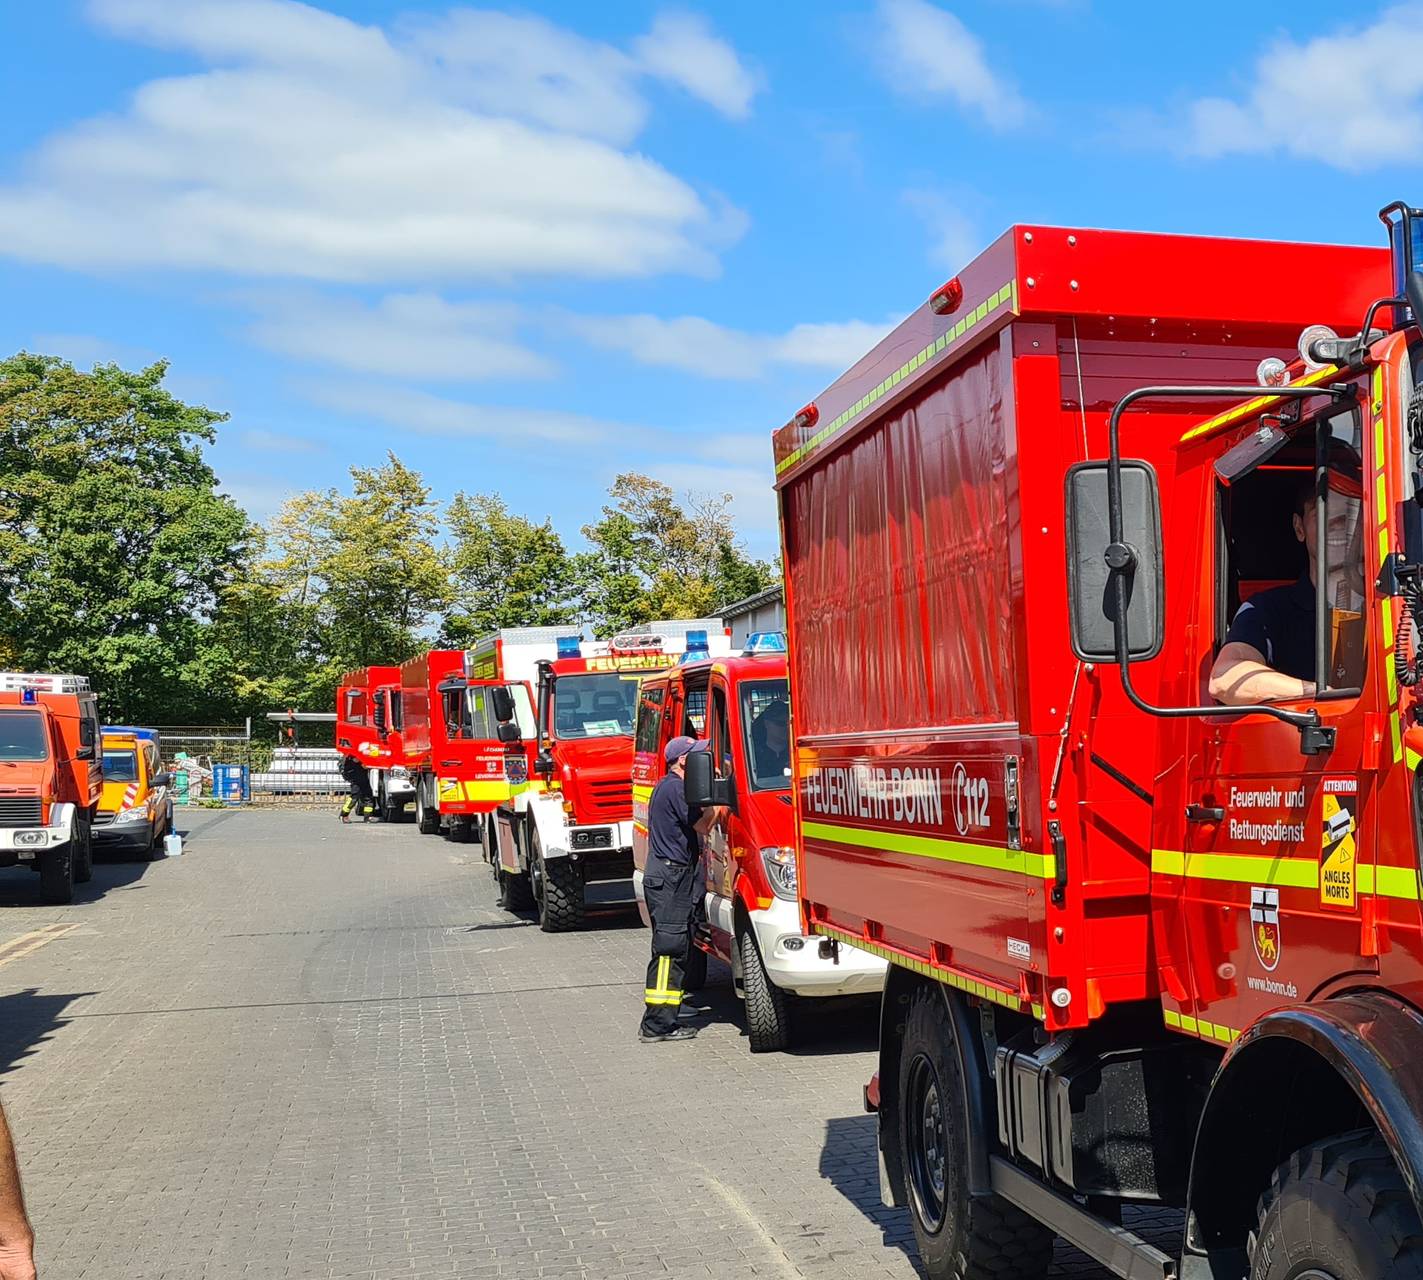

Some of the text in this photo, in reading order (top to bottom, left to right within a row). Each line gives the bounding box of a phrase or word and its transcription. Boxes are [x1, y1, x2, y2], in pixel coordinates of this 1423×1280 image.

[806, 766, 991, 827] FEUERWEHR BONN 112
[1231, 786, 1305, 808] Feuerwehr und
[1323, 780, 1357, 793] ATTENTION
[1230, 818, 1305, 845] Rettungsdienst
[1323, 870, 1351, 885] ANGLES
[1325, 886, 1350, 899] MORTS
[1247, 976, 1298, 998] www.bonn.de
